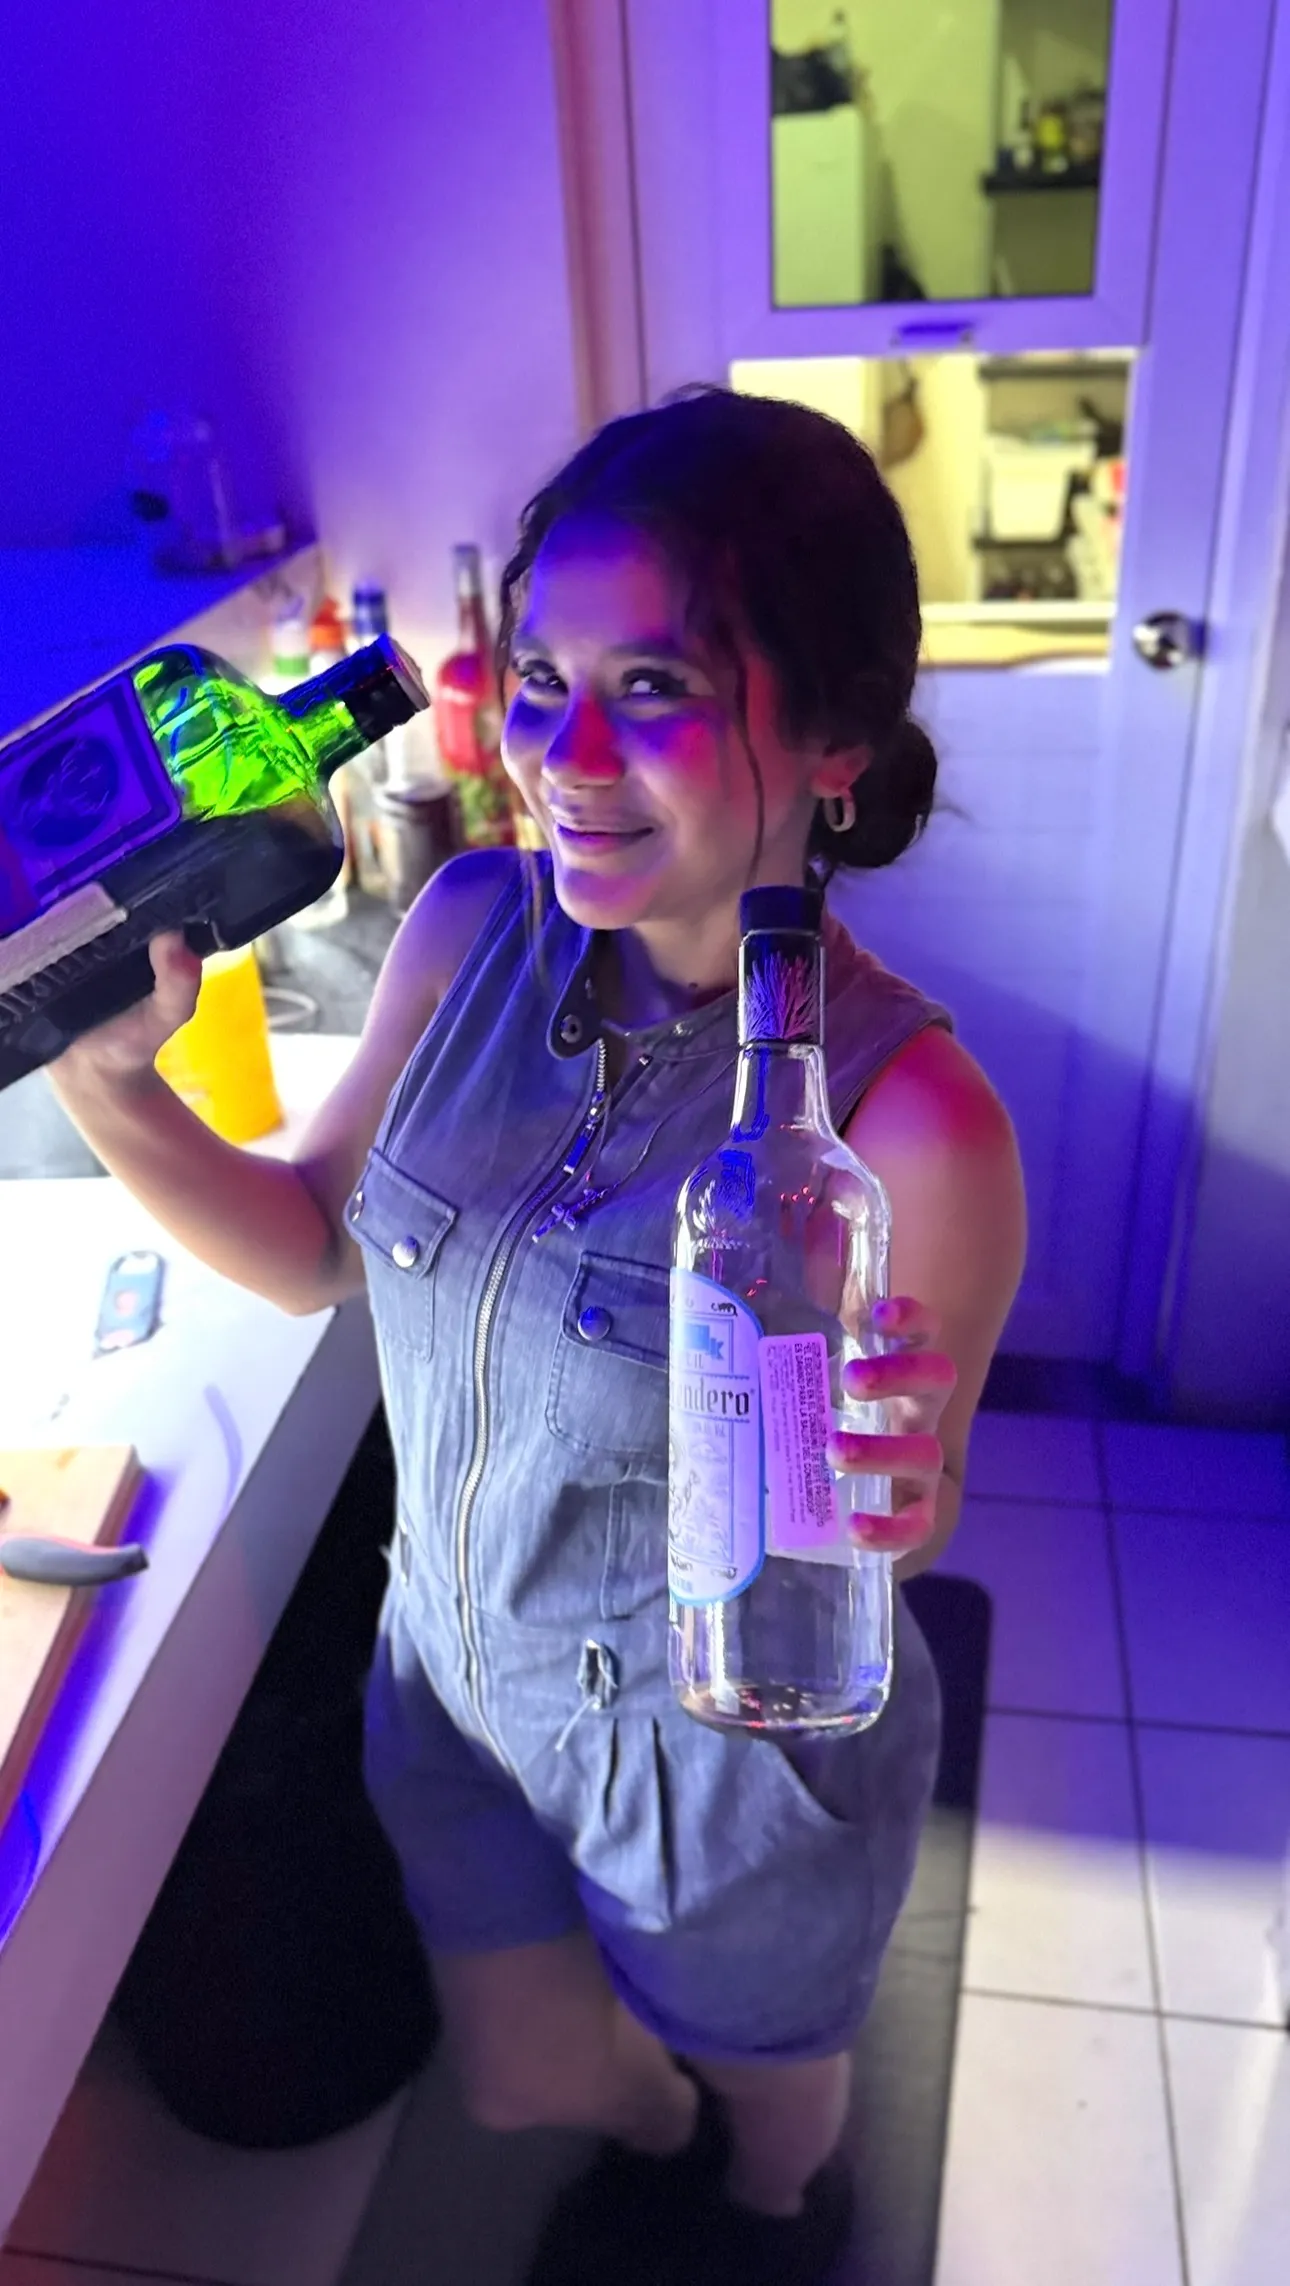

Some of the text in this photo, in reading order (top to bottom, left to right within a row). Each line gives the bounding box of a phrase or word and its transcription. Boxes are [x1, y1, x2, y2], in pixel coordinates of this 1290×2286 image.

[796, 1344, 803, 1353] ES
[807, 1389, 814, 1400] EN
[809, 1402, 815, 1411] EL
[800, 1407, 807, 1417] LA
[801, 1419, 809, 1444] SALUD
